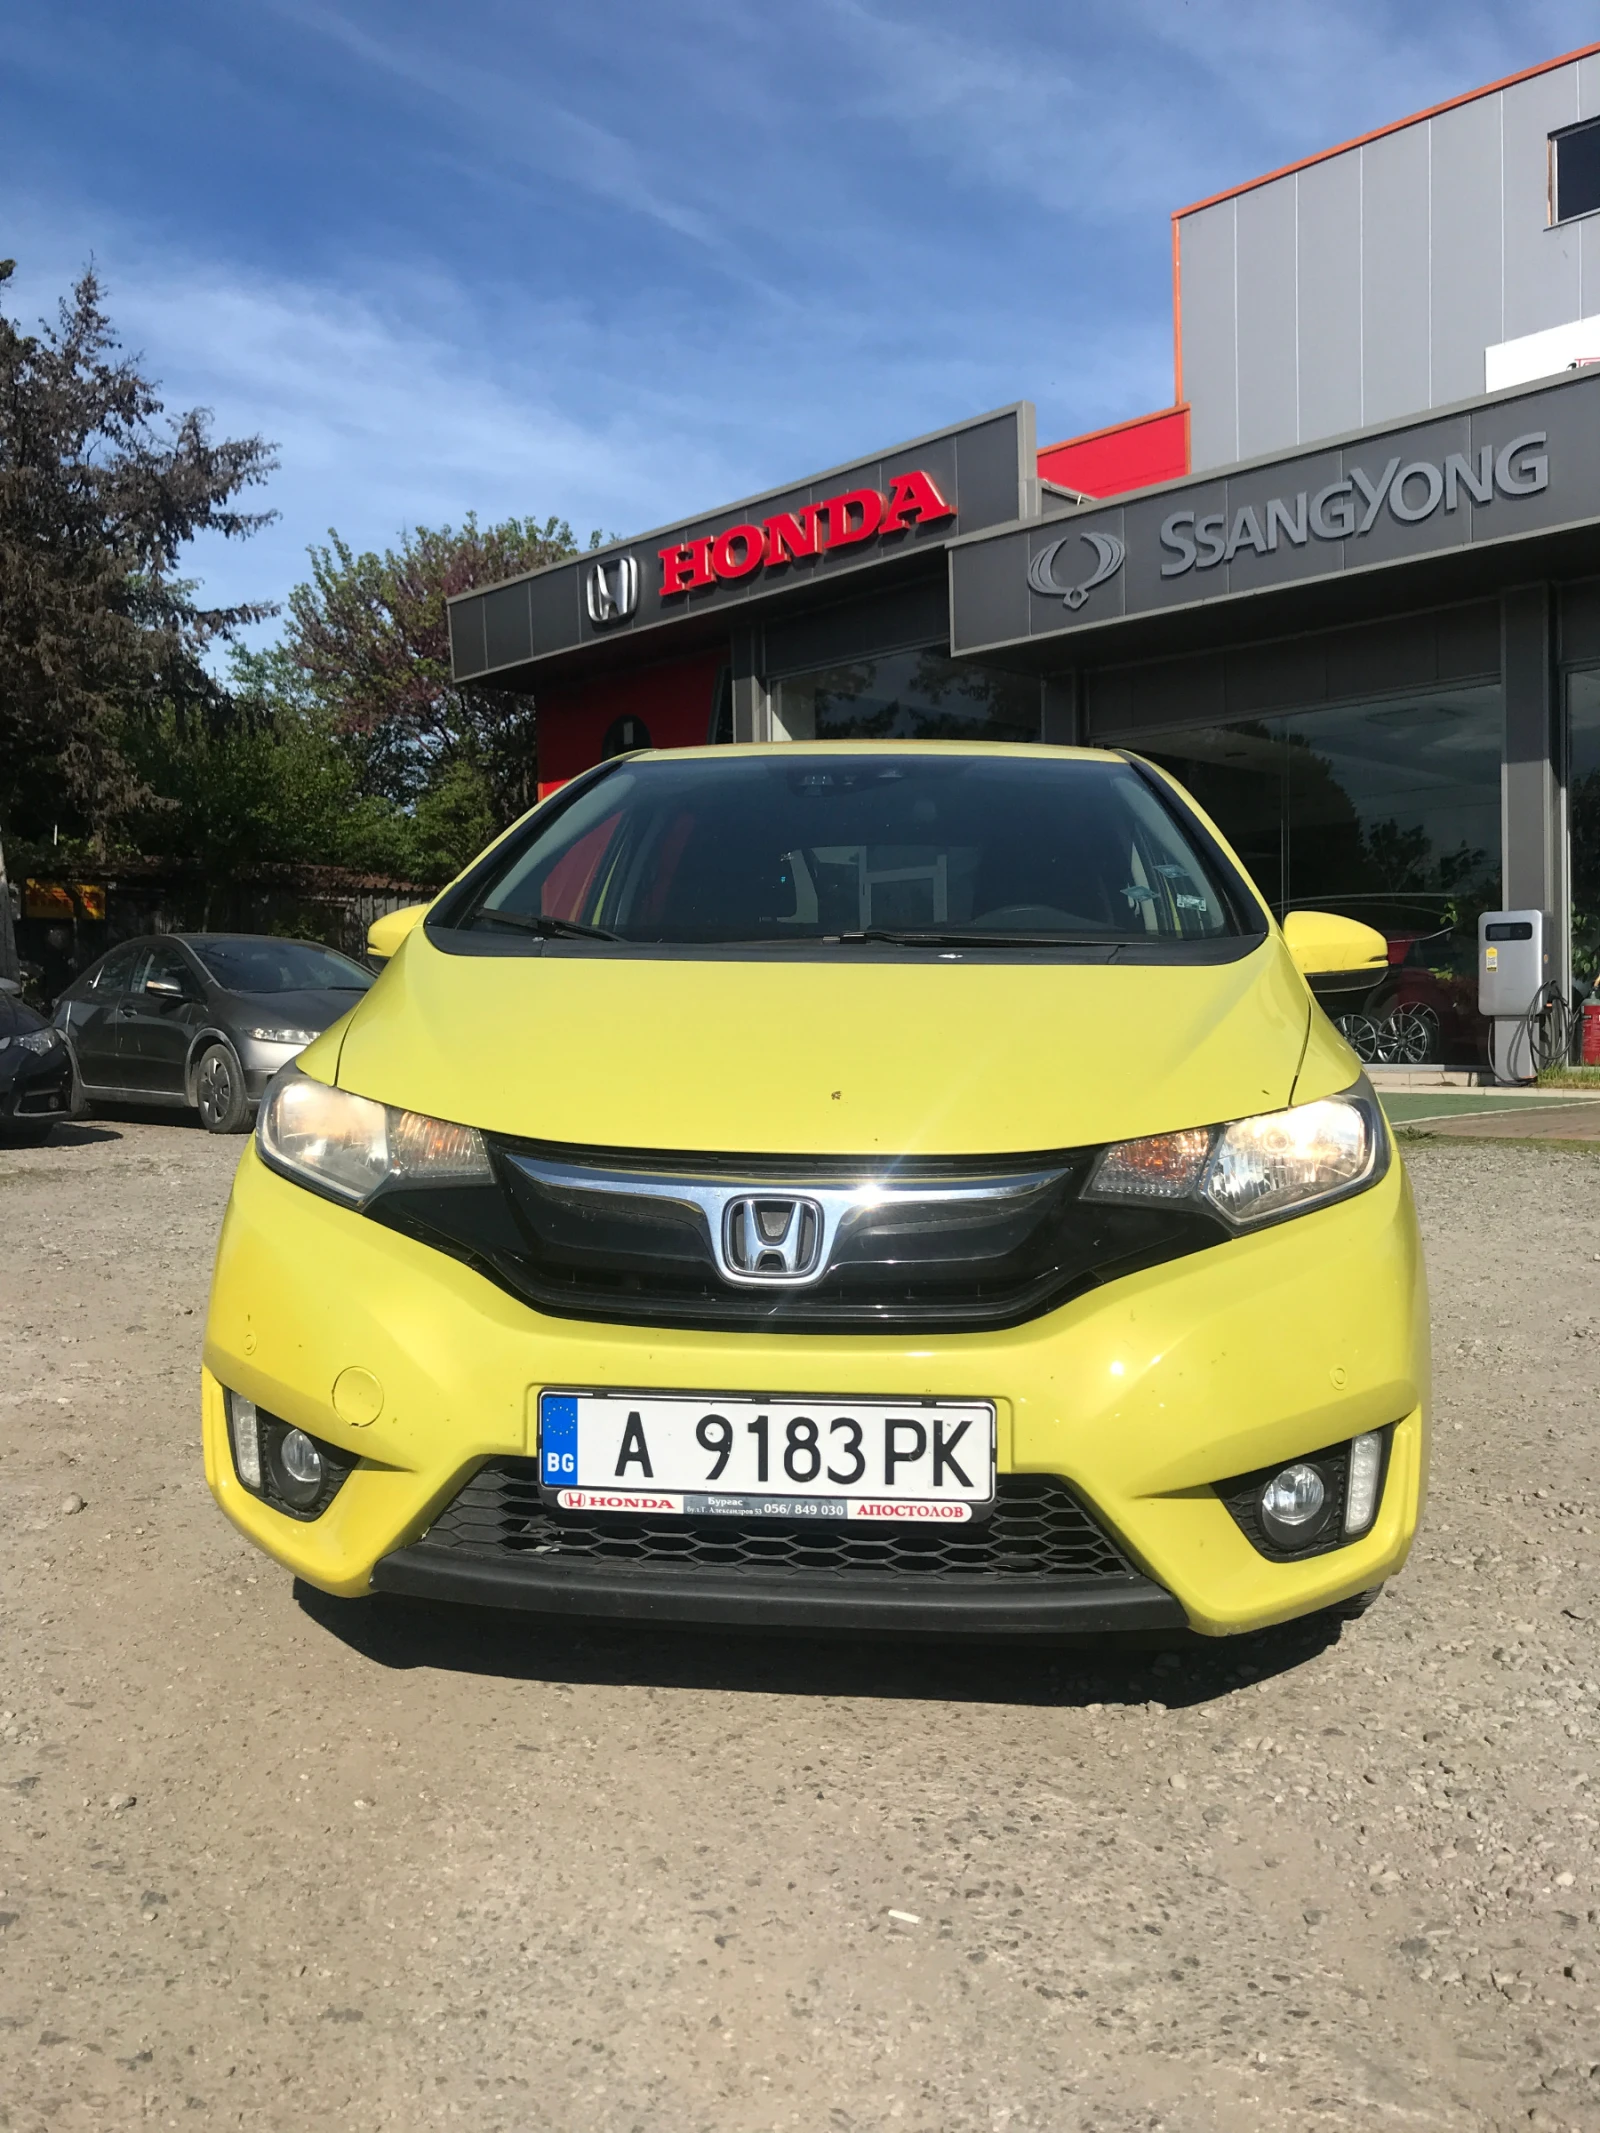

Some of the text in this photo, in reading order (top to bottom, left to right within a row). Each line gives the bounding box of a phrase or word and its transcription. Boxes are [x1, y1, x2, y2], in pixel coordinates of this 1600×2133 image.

[1161, 431, 1549, 577] SSANGYONG
[658, 469, 958, 596] HONDA
[546, 1453, 575, 1474] BG
[589, 1496, 676, 1509] HONDA
[707, 1496, 744, 1507] Бургас
[763, 1503, 844, 1516] 056/ 849 030
[857, 1503, 964, 1518] АПОСТОЛОВ
